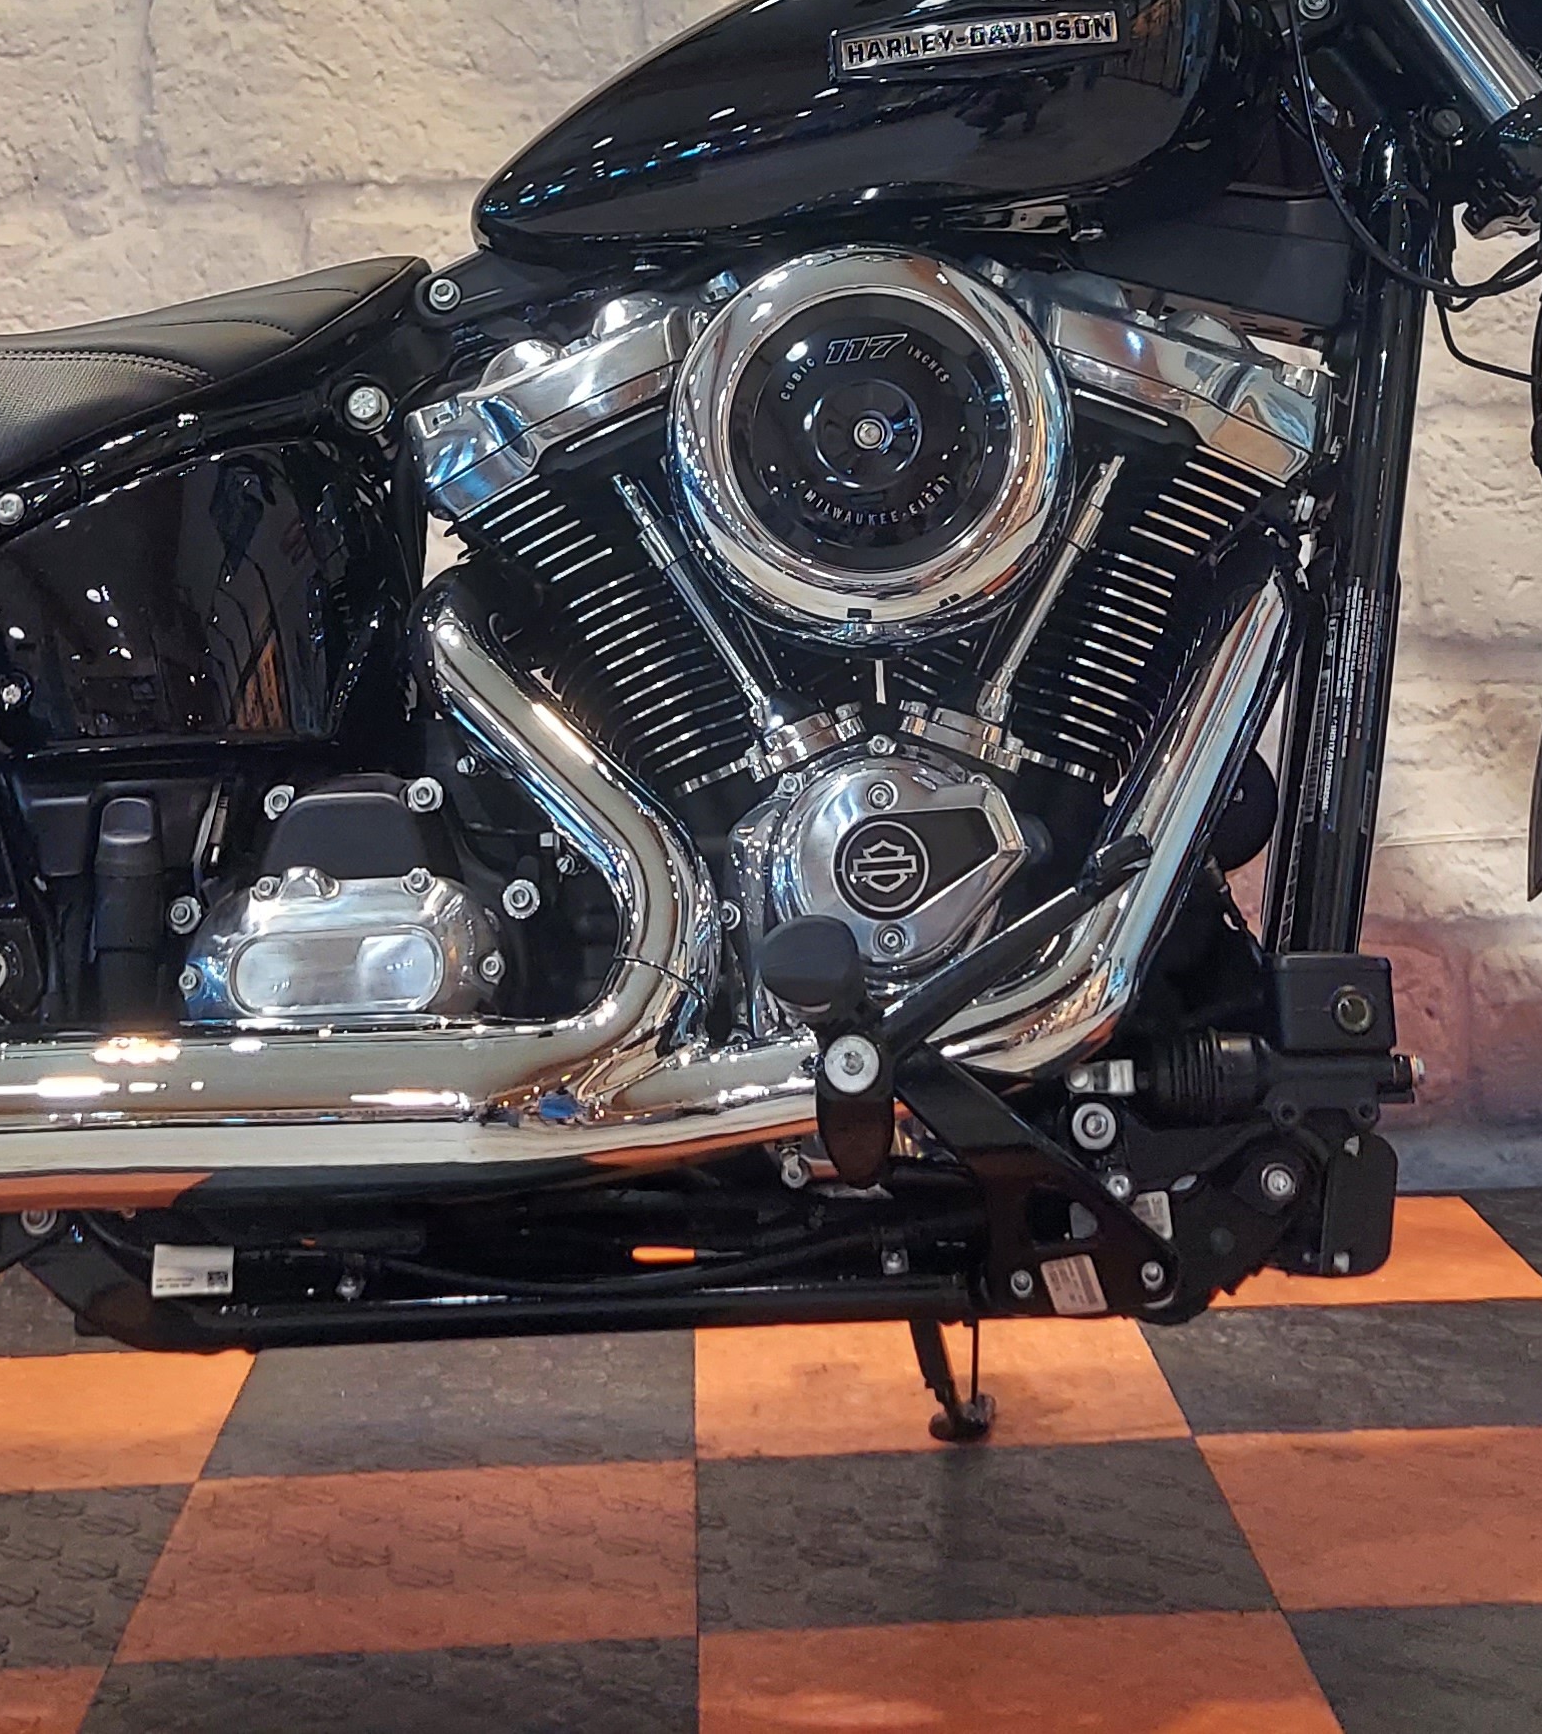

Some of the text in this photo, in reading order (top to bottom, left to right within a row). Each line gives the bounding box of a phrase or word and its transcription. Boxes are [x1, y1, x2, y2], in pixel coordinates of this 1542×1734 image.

[847, 16, 1112, 63] HARLEY-DAVIDSON
[780, 332, 951, 401] CUBIC 117 INCHES
